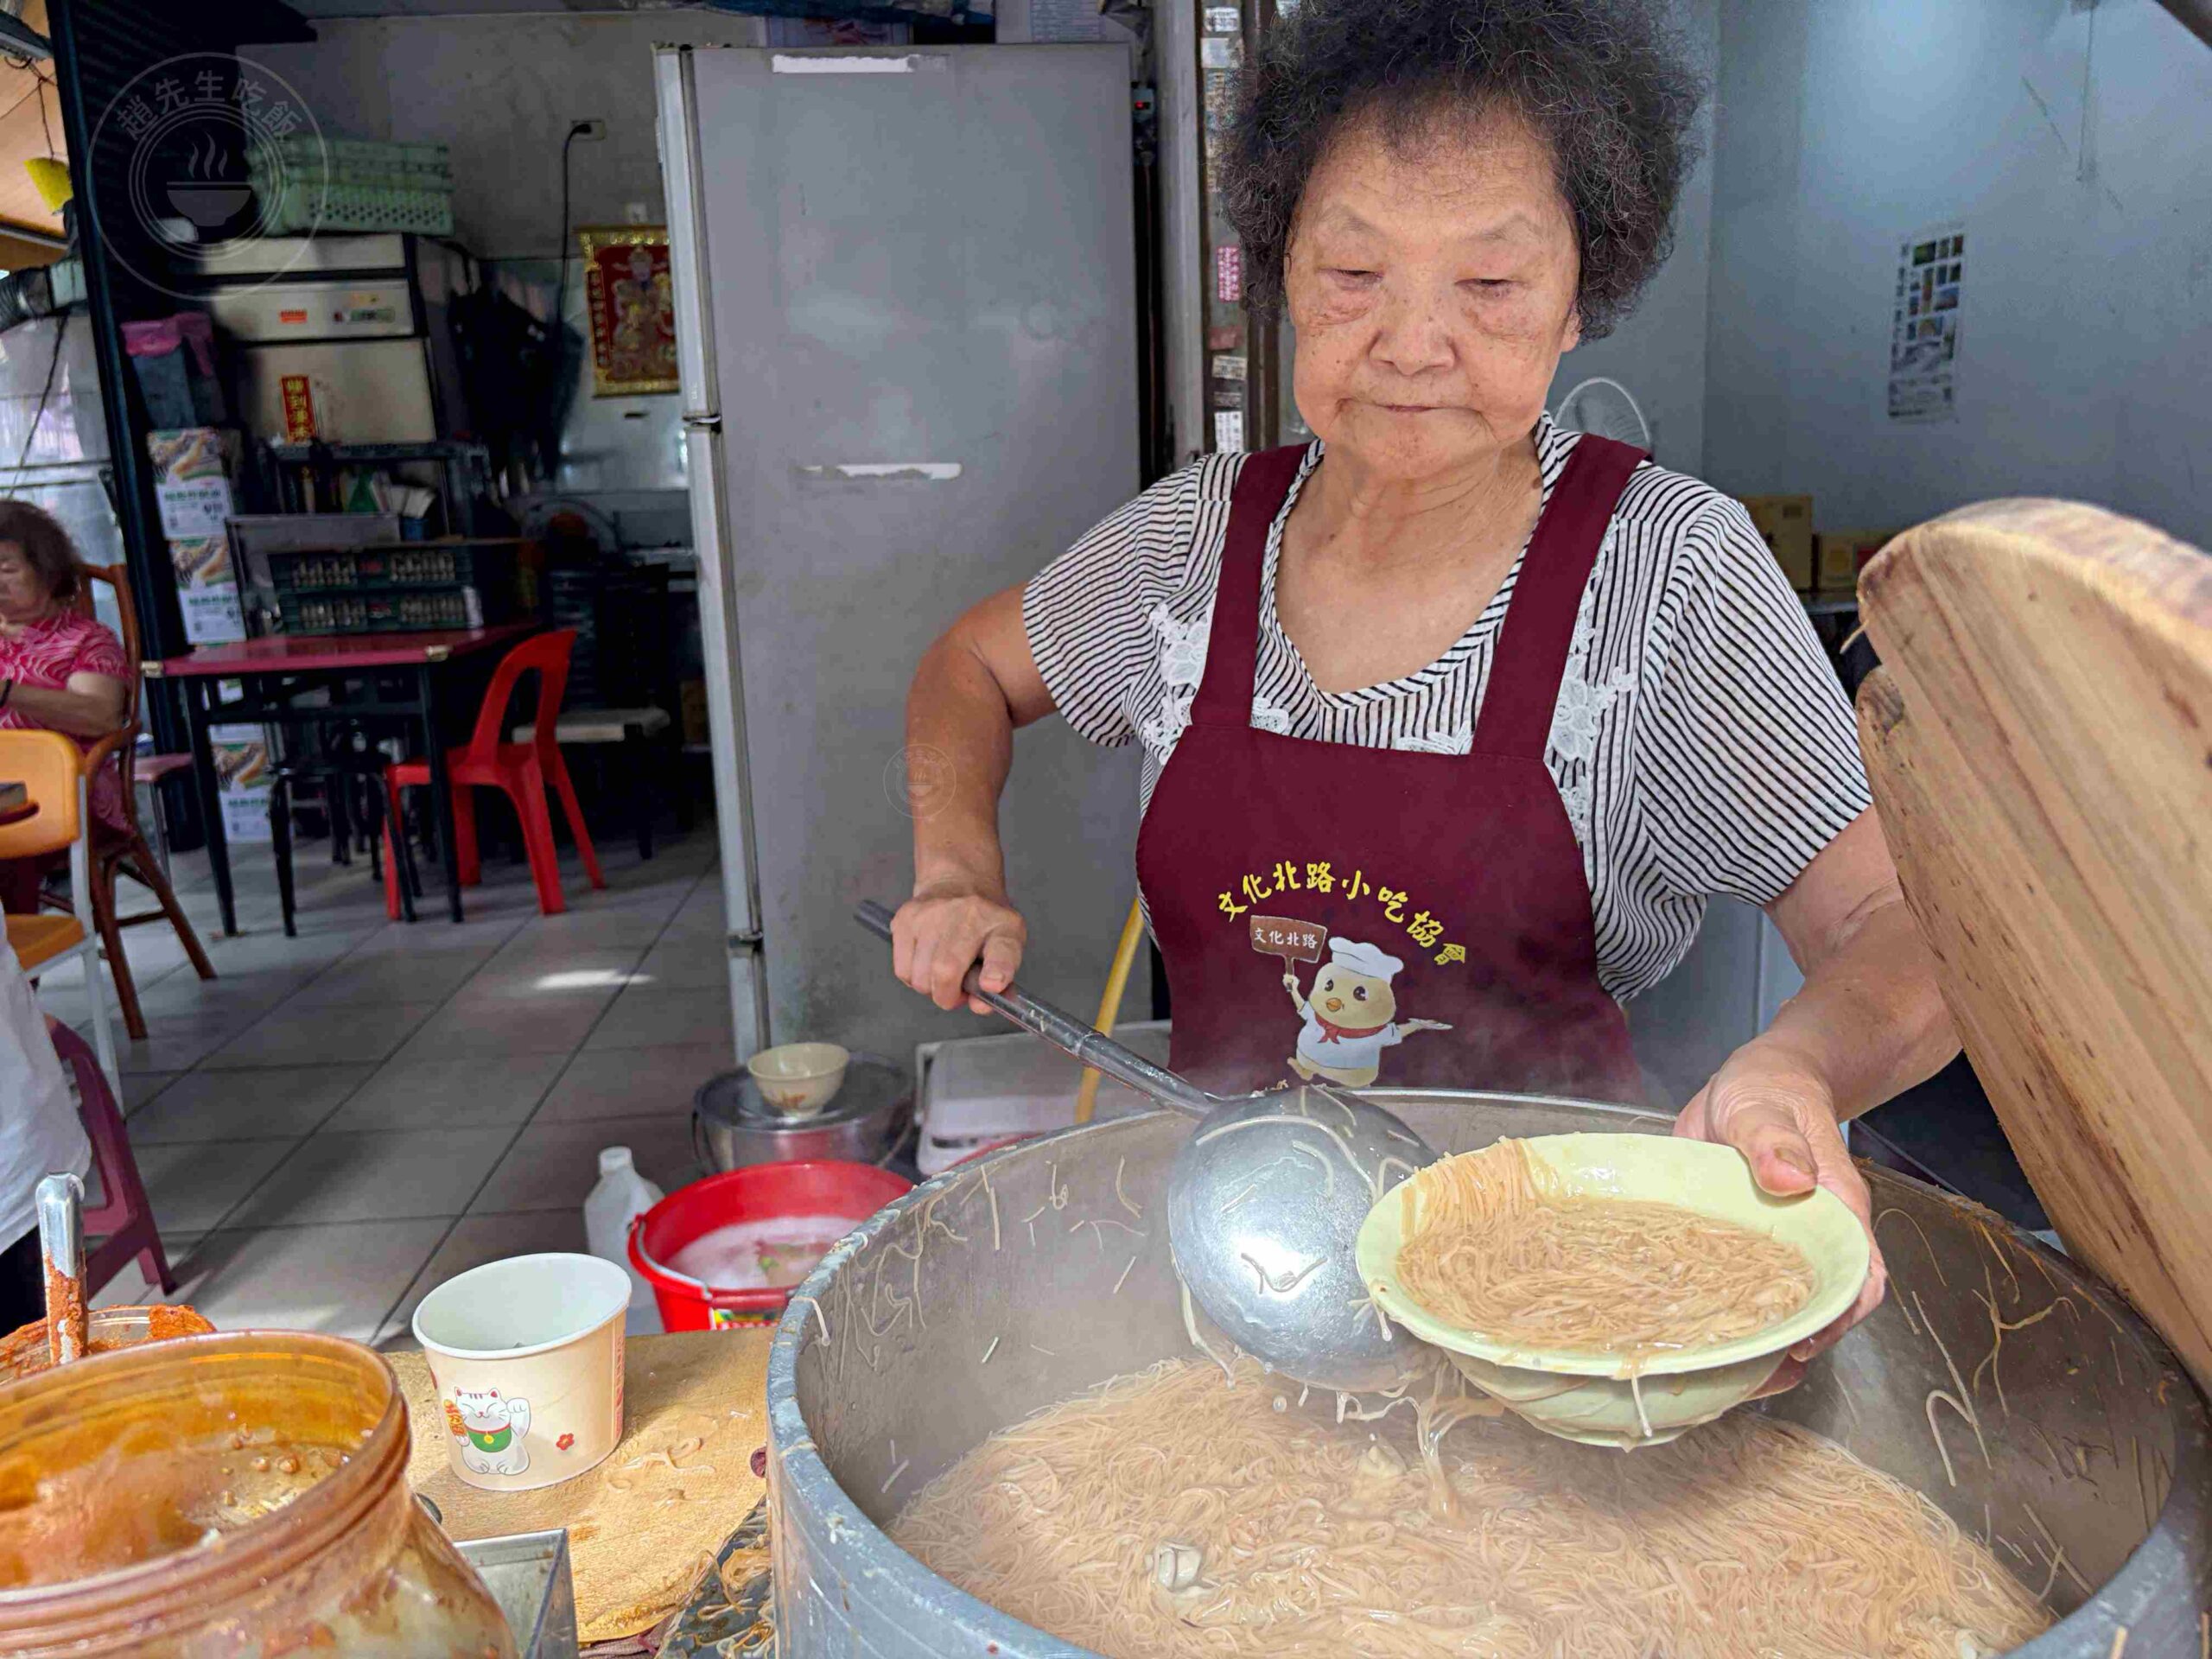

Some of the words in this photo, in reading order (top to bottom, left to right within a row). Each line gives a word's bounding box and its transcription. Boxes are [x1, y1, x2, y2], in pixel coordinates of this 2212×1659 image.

[1217, 861, 1466, 966] 文化北路小吃協會
[1253, 926, 1319, 950] 文化北路
